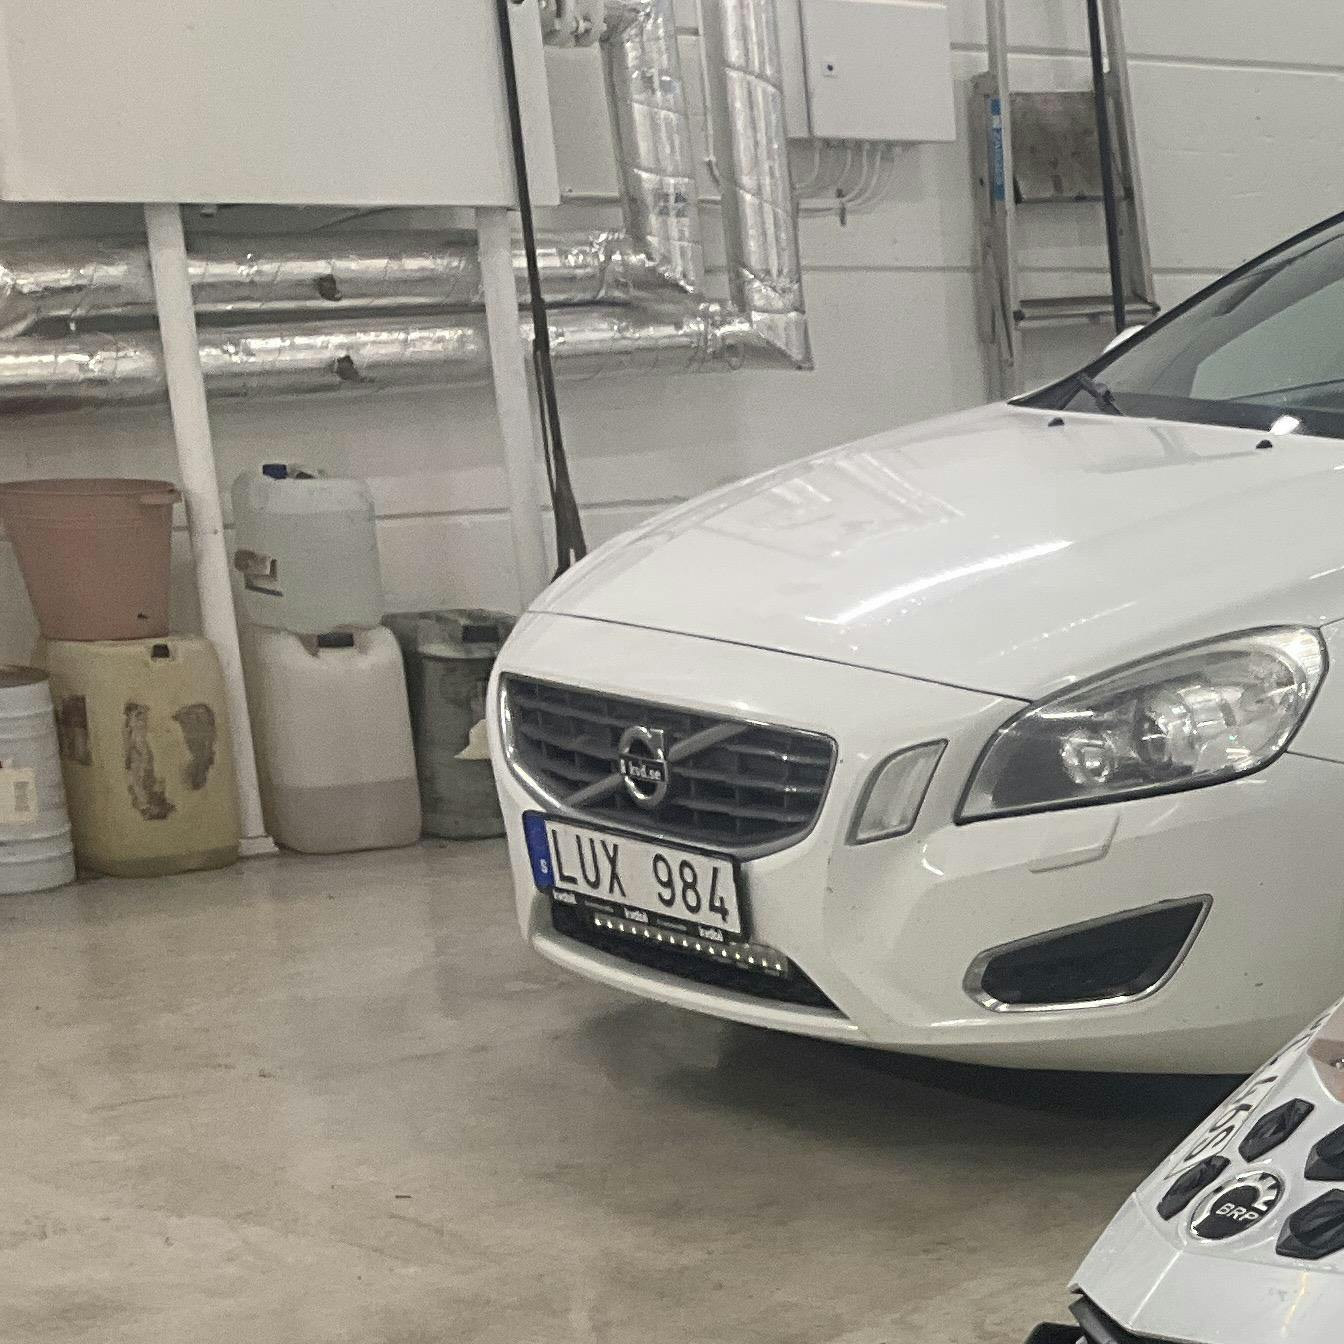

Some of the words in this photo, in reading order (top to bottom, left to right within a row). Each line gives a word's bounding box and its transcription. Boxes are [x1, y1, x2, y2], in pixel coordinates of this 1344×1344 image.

[552, 829, 627, 898] LUX
[653, 853, 730, 923] 984
[1216, 1203, 1259, 1221] BRP
